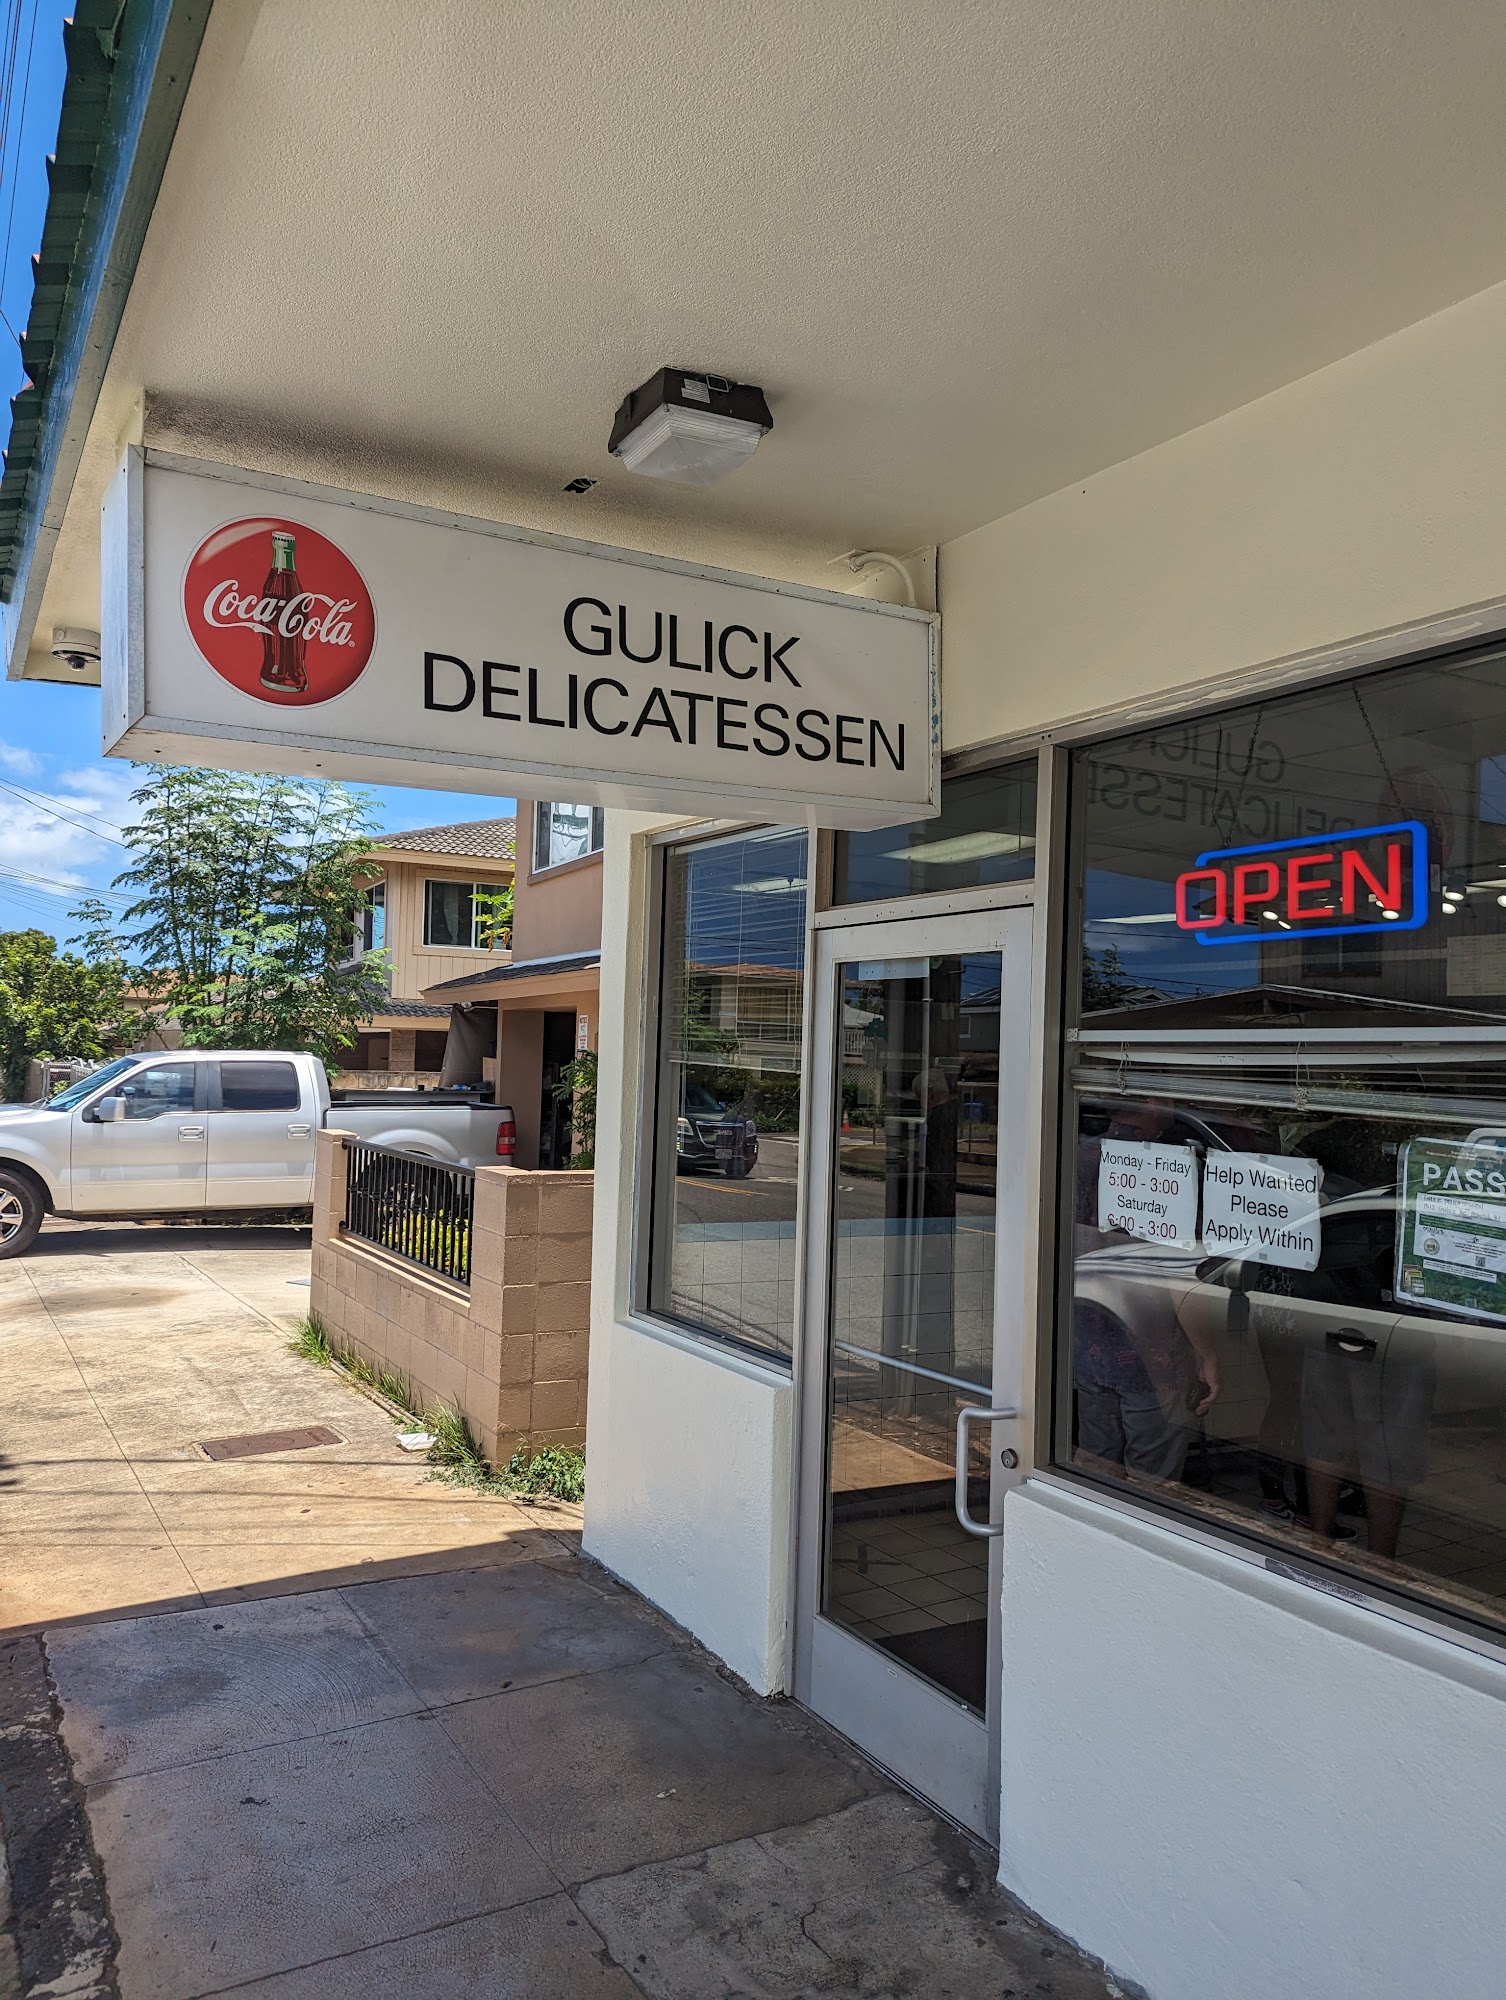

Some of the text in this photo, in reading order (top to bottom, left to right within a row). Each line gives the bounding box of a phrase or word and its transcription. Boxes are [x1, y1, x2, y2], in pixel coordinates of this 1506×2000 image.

[203, 579, 357, 646] Coca-Cola
[563, 595, 803, 689] GULICK
[423, 651, 906, 771] DELICATESSEN
[1175, 844, 1402, 930] OPEN
[1101, 1150, 1143, 1171] Monday
[1155, 1157, 1191, 1177] Friday
[1206, 1164, 1317, 1194] Help Wanted
[1108, 1171, 1136, 1189] 5:00
[1150, 1177, 1179, 1195] 3:00
[1423, 1162, 1506, 1198] PASS
[1117, 1194, 1168, 1217] Saturday
[1231, 1194, 1289, 1219] Please
[1147, 1221, 1177, 1240] 3:00
[1206, 1219, 1314, 1252] Apply Within
